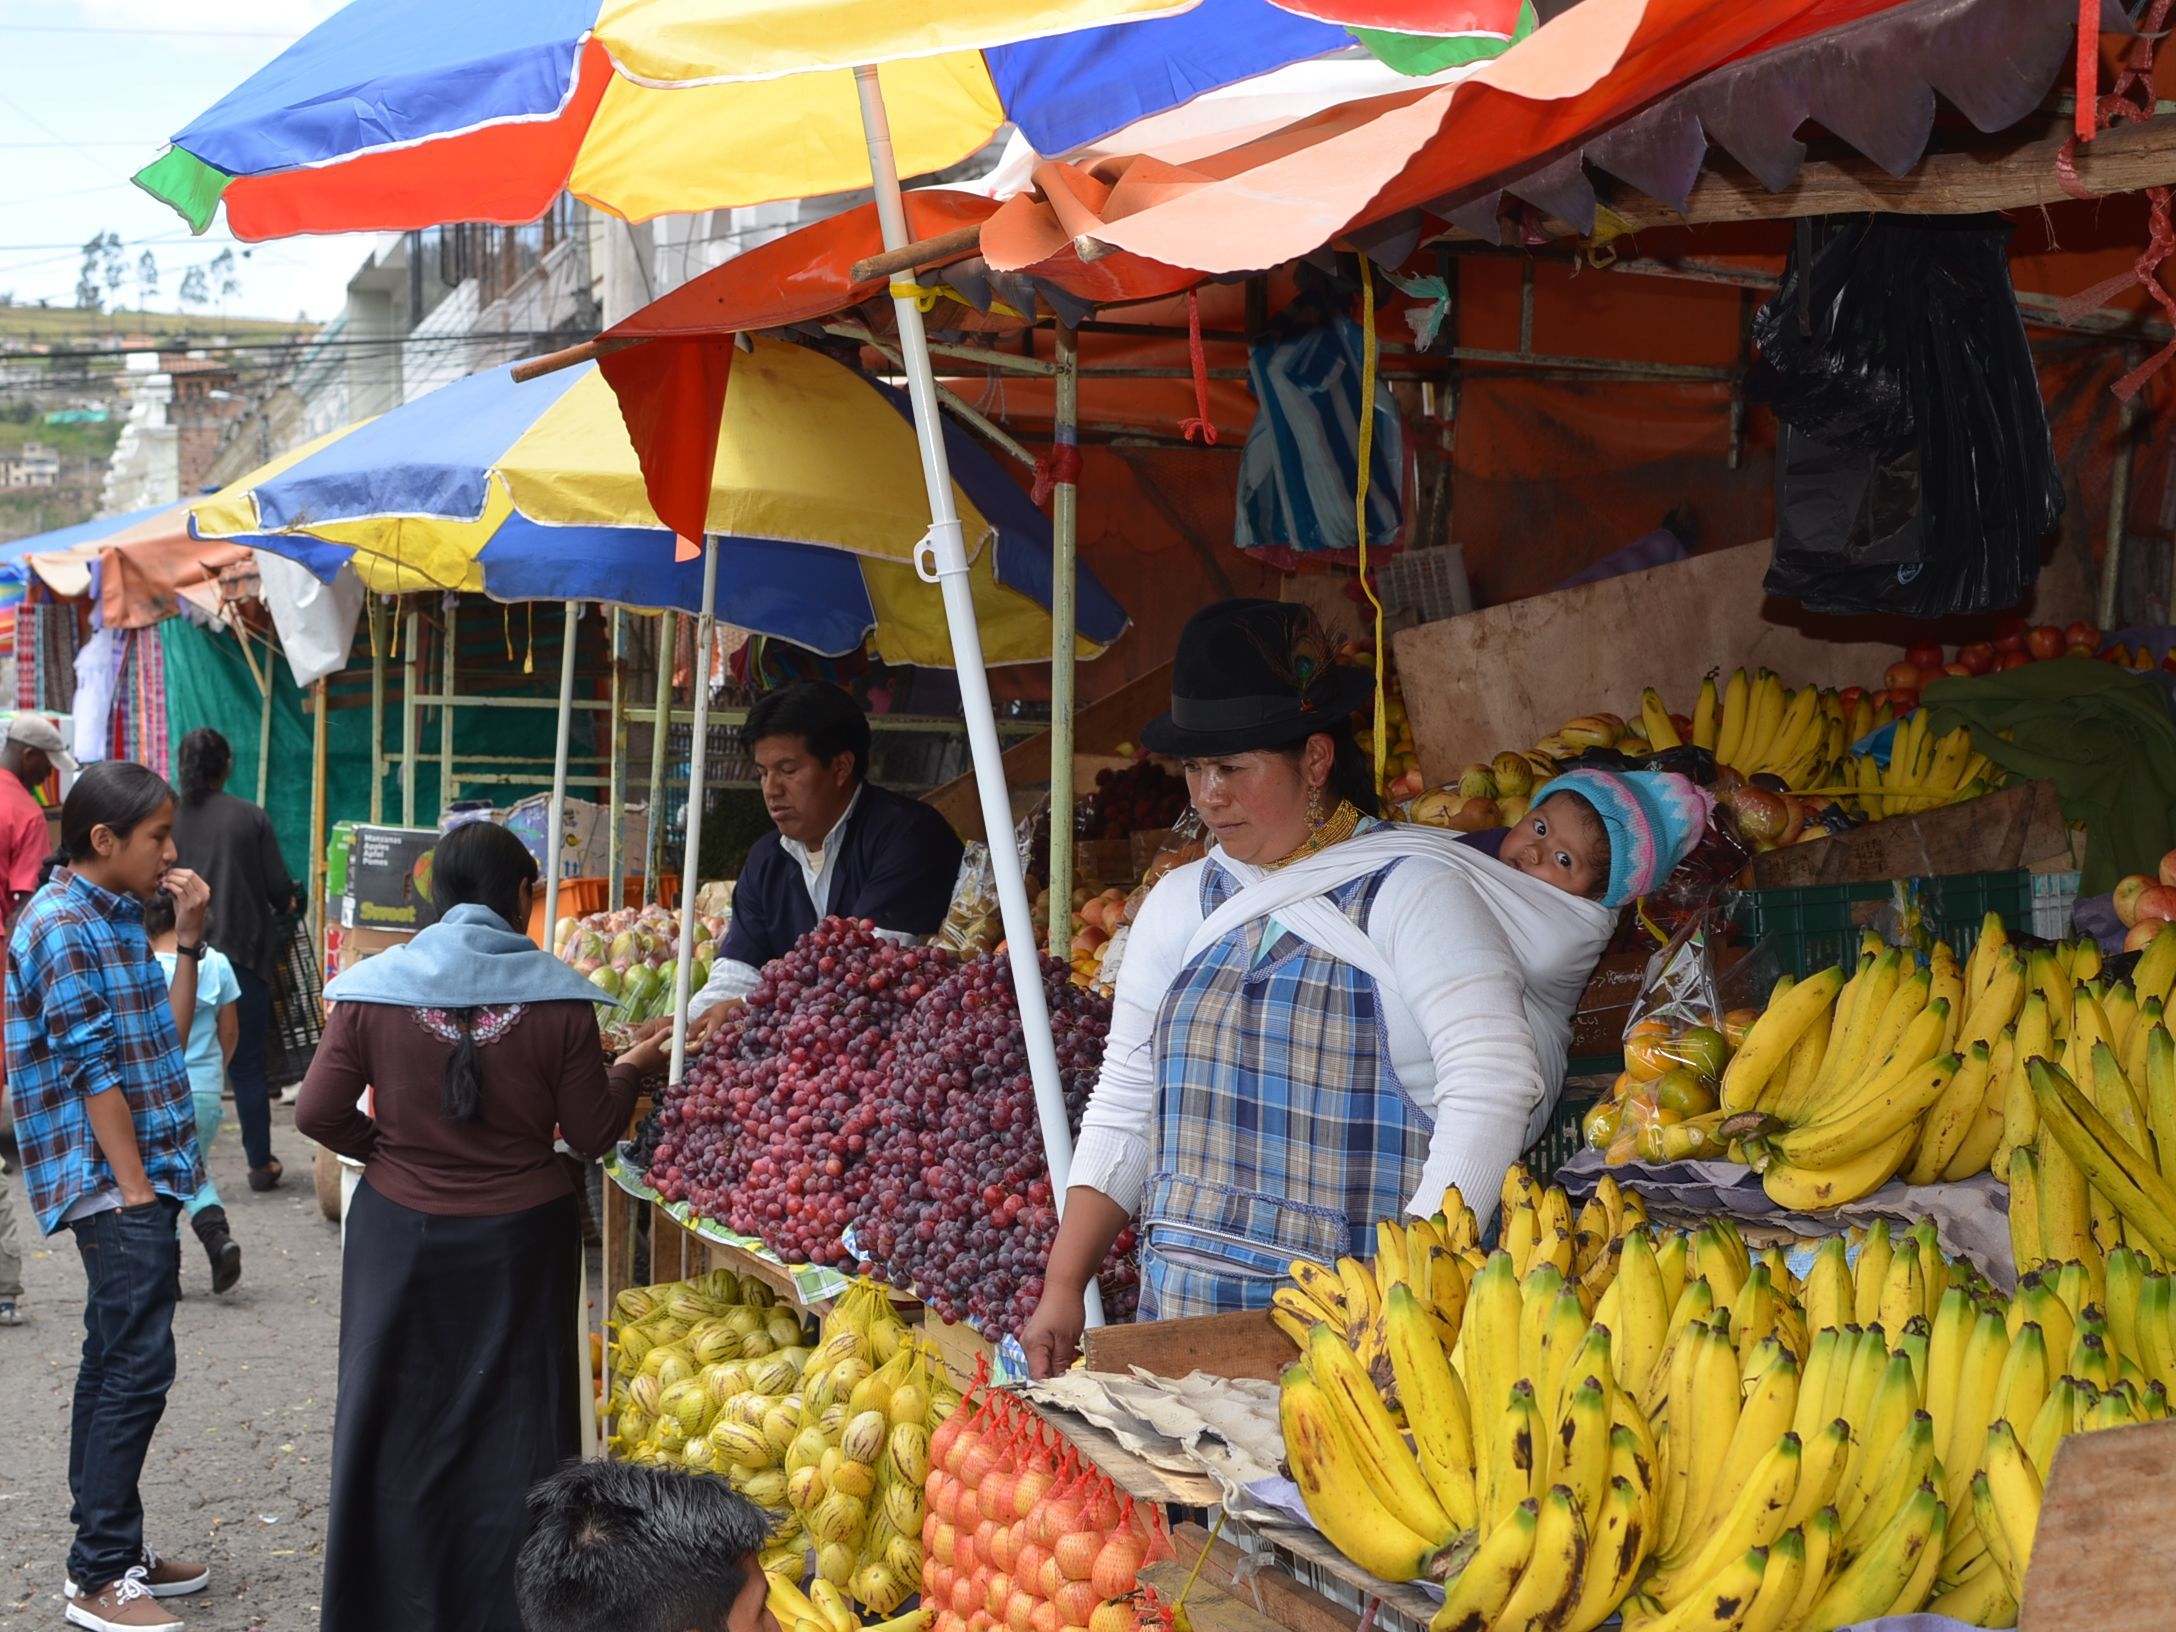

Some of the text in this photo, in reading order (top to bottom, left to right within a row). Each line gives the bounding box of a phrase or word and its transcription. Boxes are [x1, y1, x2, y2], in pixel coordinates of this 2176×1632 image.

[365, 834, 401, 844] Manzanas
[364, 842, 389, 851] Apples
[363, 850, 384, 858] Apfel
